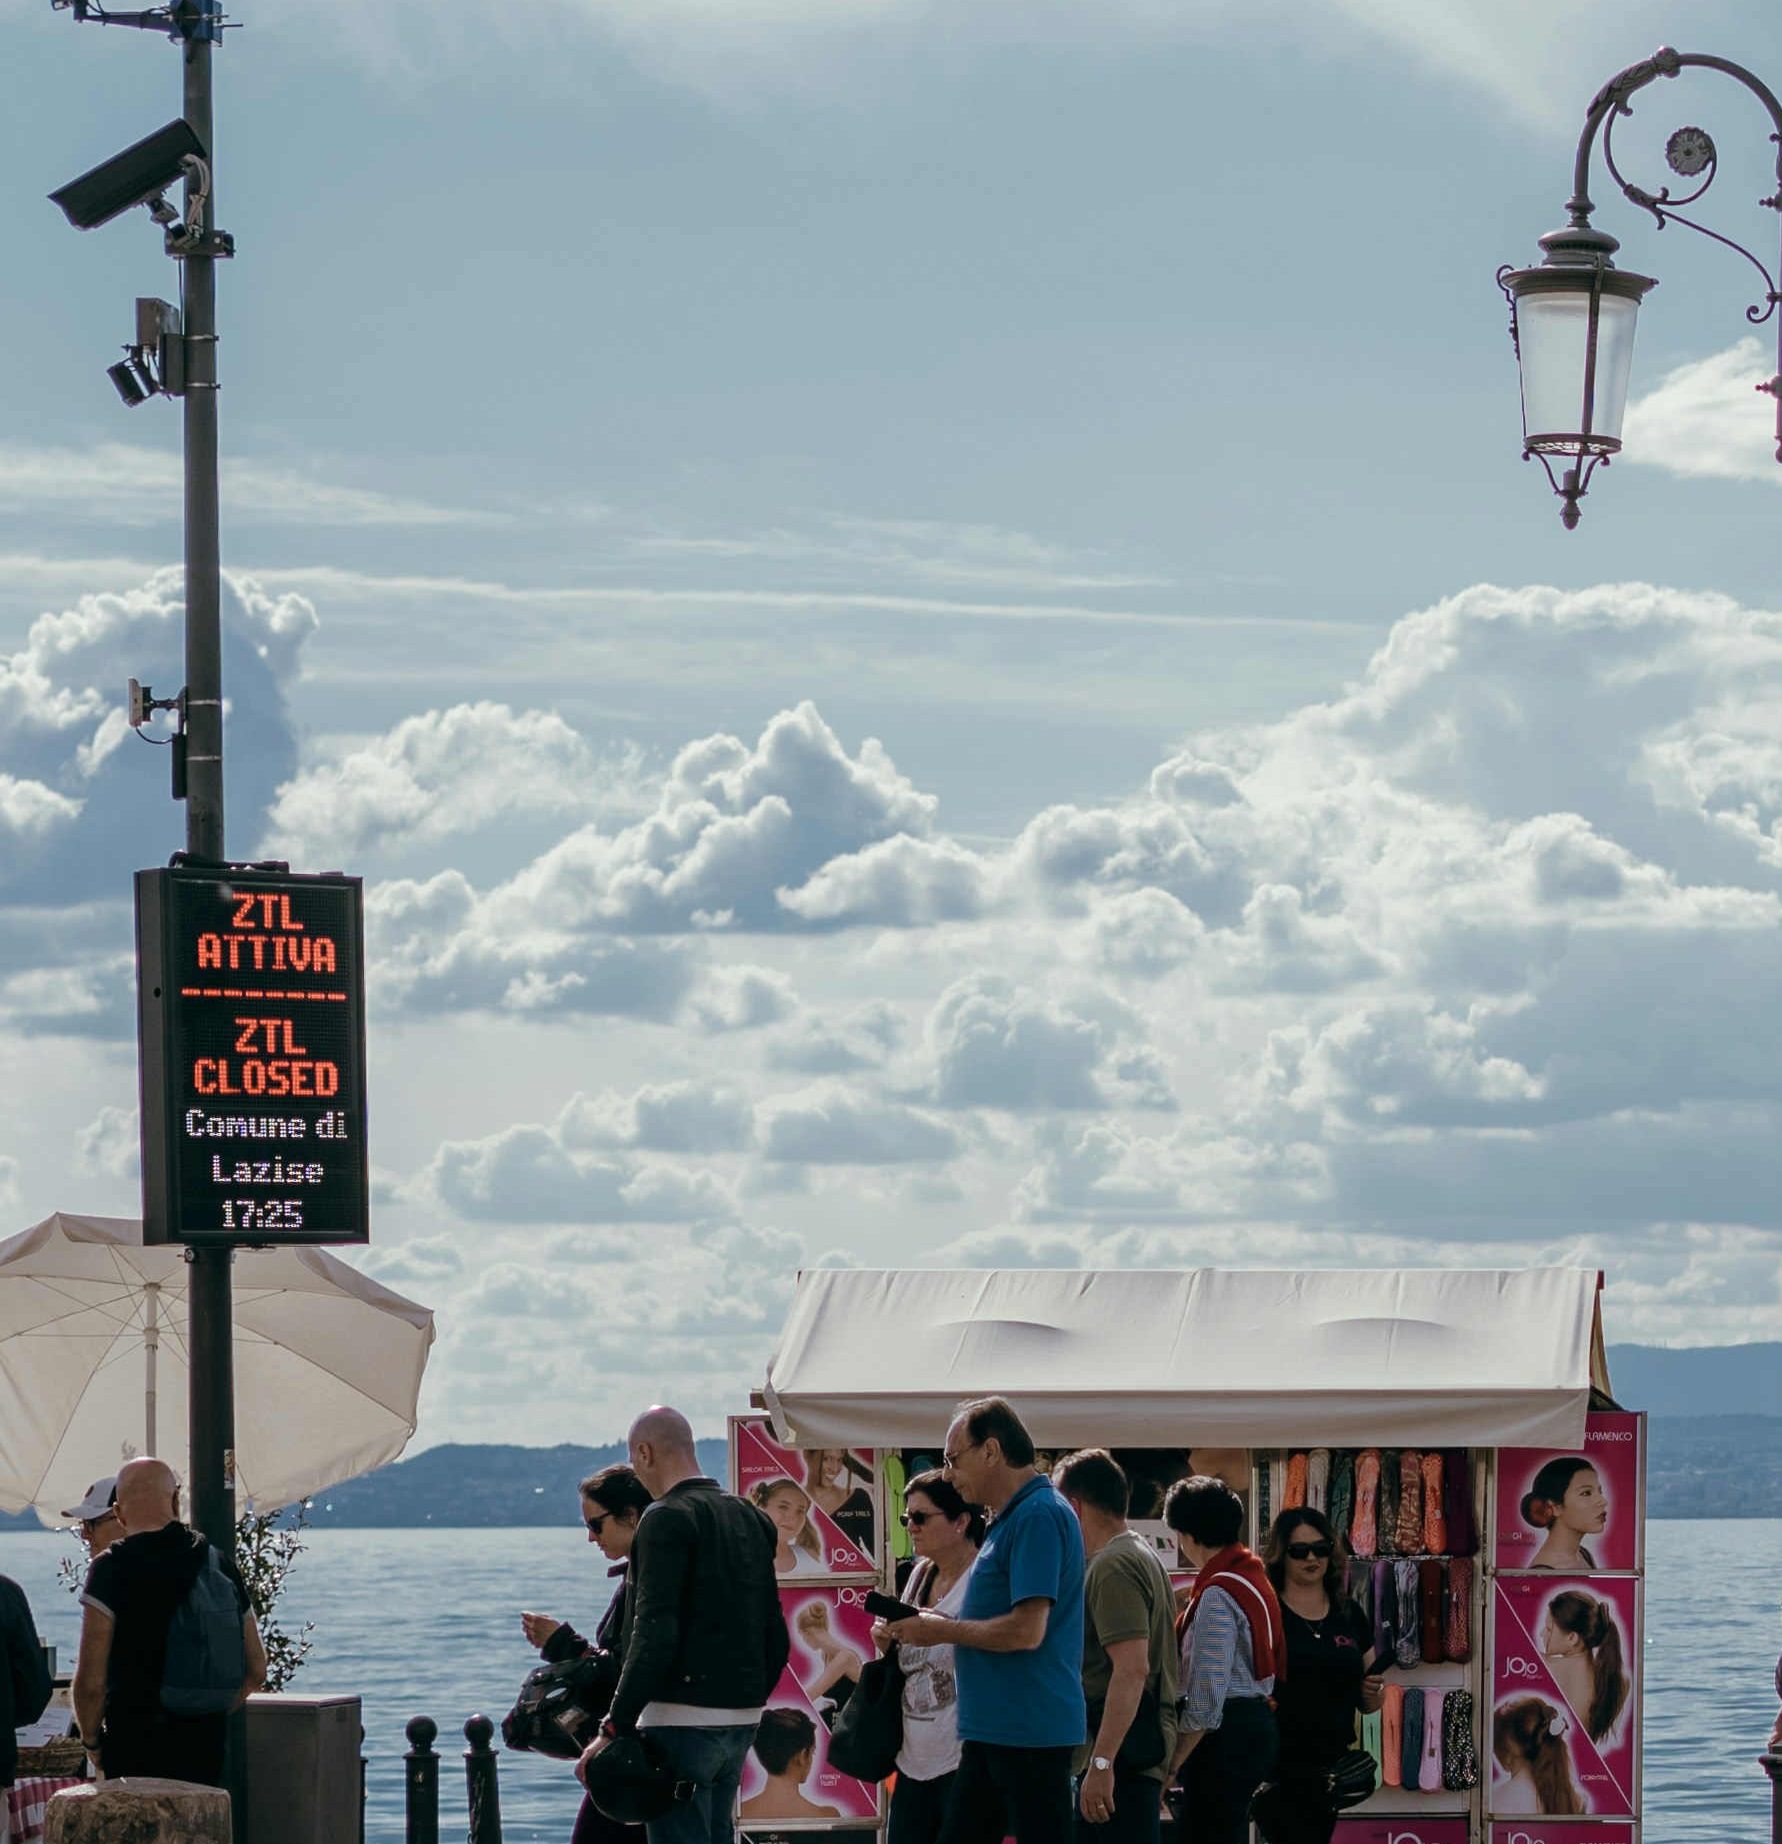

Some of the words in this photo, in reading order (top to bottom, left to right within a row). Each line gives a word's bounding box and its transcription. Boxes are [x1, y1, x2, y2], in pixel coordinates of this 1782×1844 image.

[231, 892, 304, 930] ZTL
[197, 932, 337, 973] ATTIVA
[234, 1017, 306, 1055] ZTL
[193, 1058, 339, 1097] CLOSED
[185, 1108, 306, 1139] Comune
[315, 1111, 347, 1139] di
[212, 1155, 324, 1183] Lazise
[222, 1199, 303, 1229] 17:25
[1584, 1431, 1633, 1442] FLAMENCO
